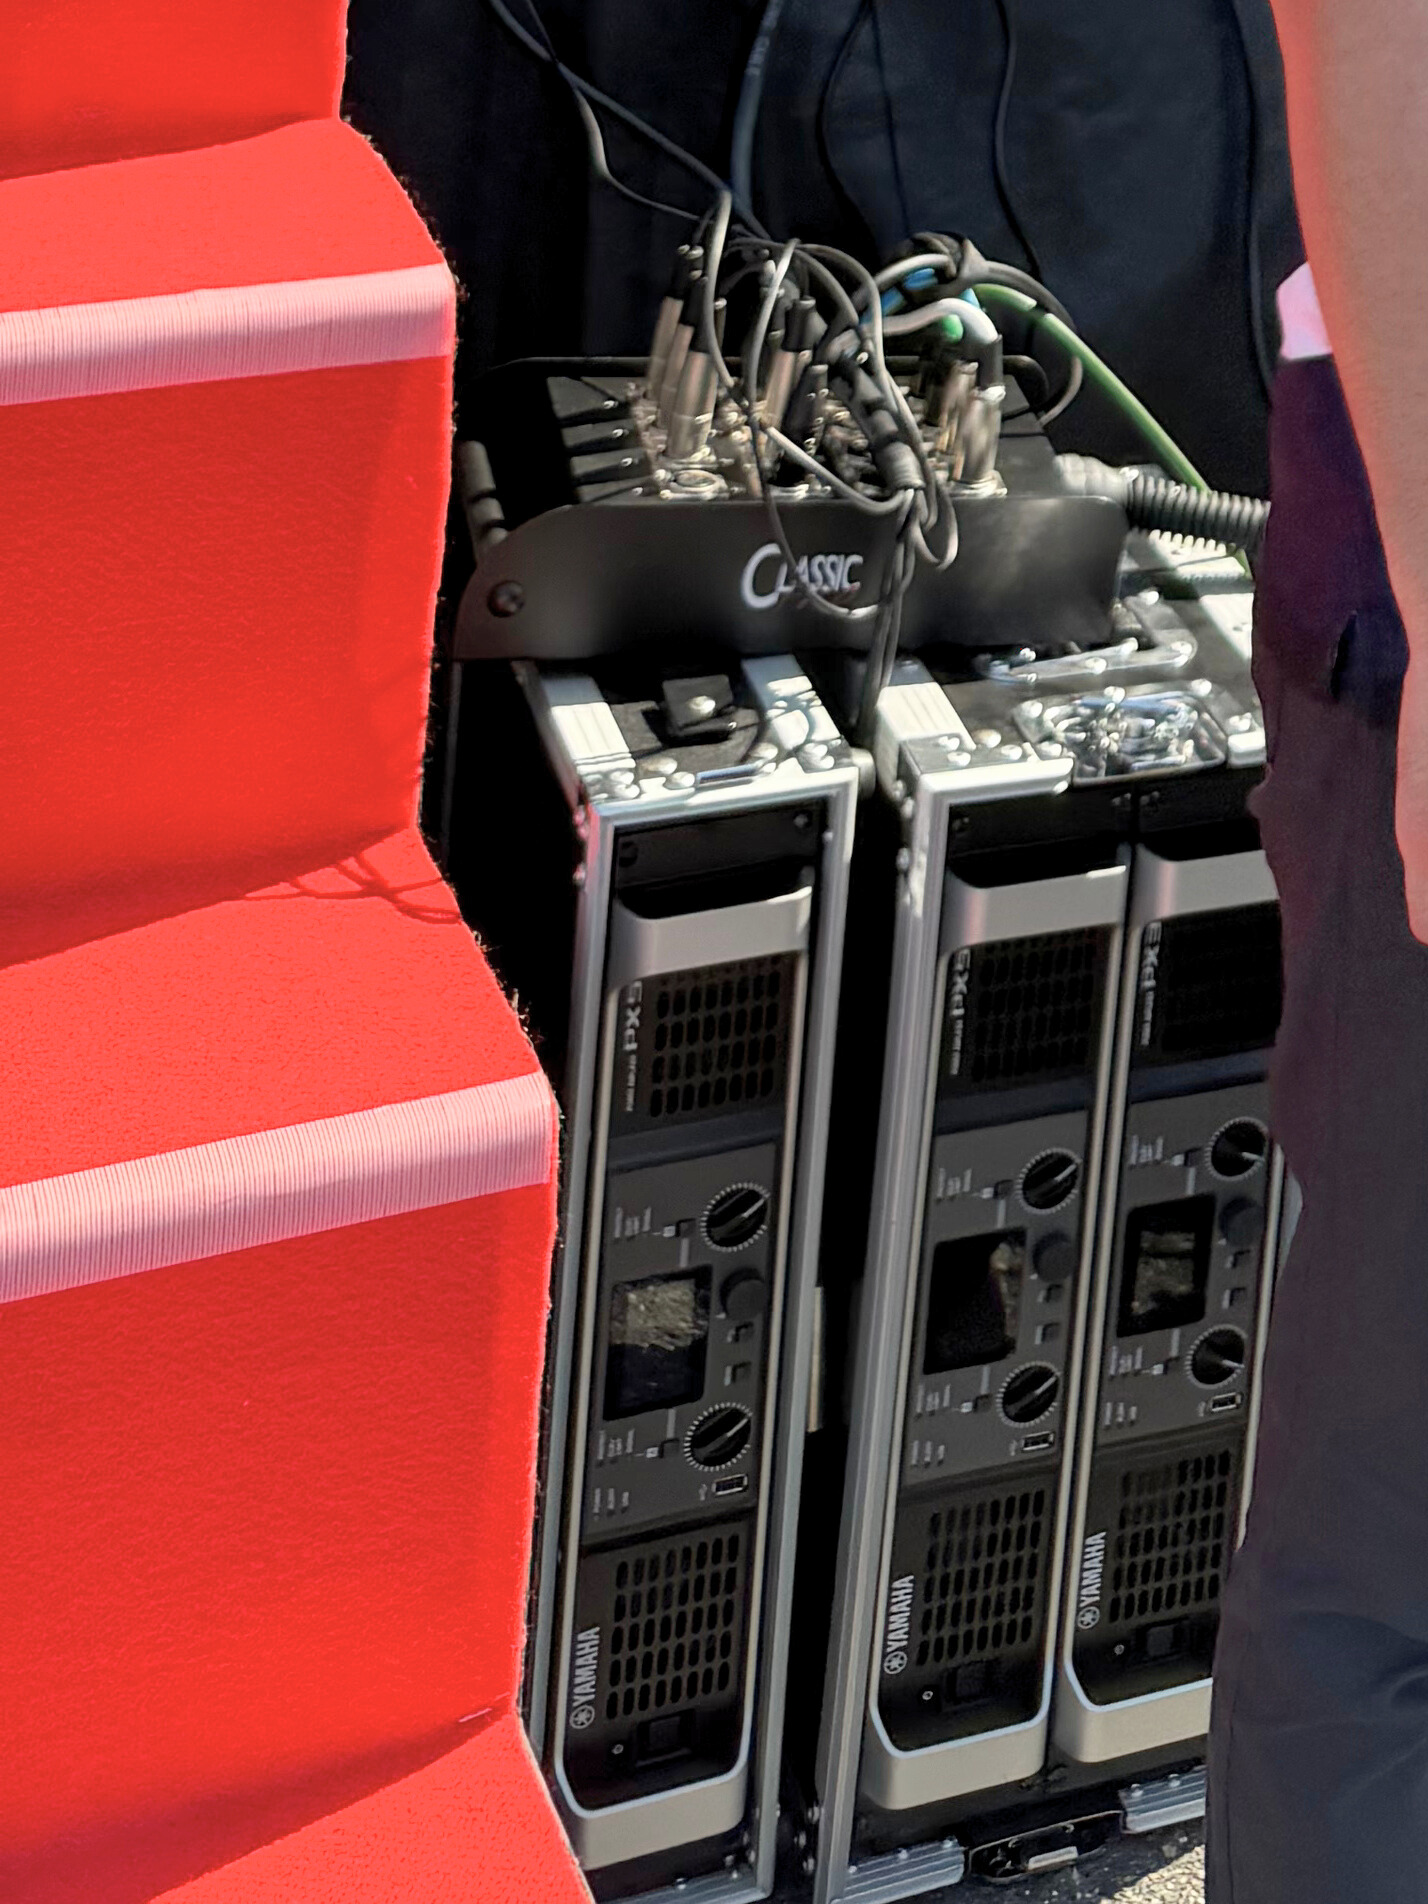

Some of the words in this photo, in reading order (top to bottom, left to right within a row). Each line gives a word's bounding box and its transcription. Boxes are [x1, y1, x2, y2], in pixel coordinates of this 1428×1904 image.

[1079, 1531, 1107, 1608] YAMAHA
[886, 1574, 915, 1653] YAMAHA
[572, 1626, 601, 1707] YAMAHA
